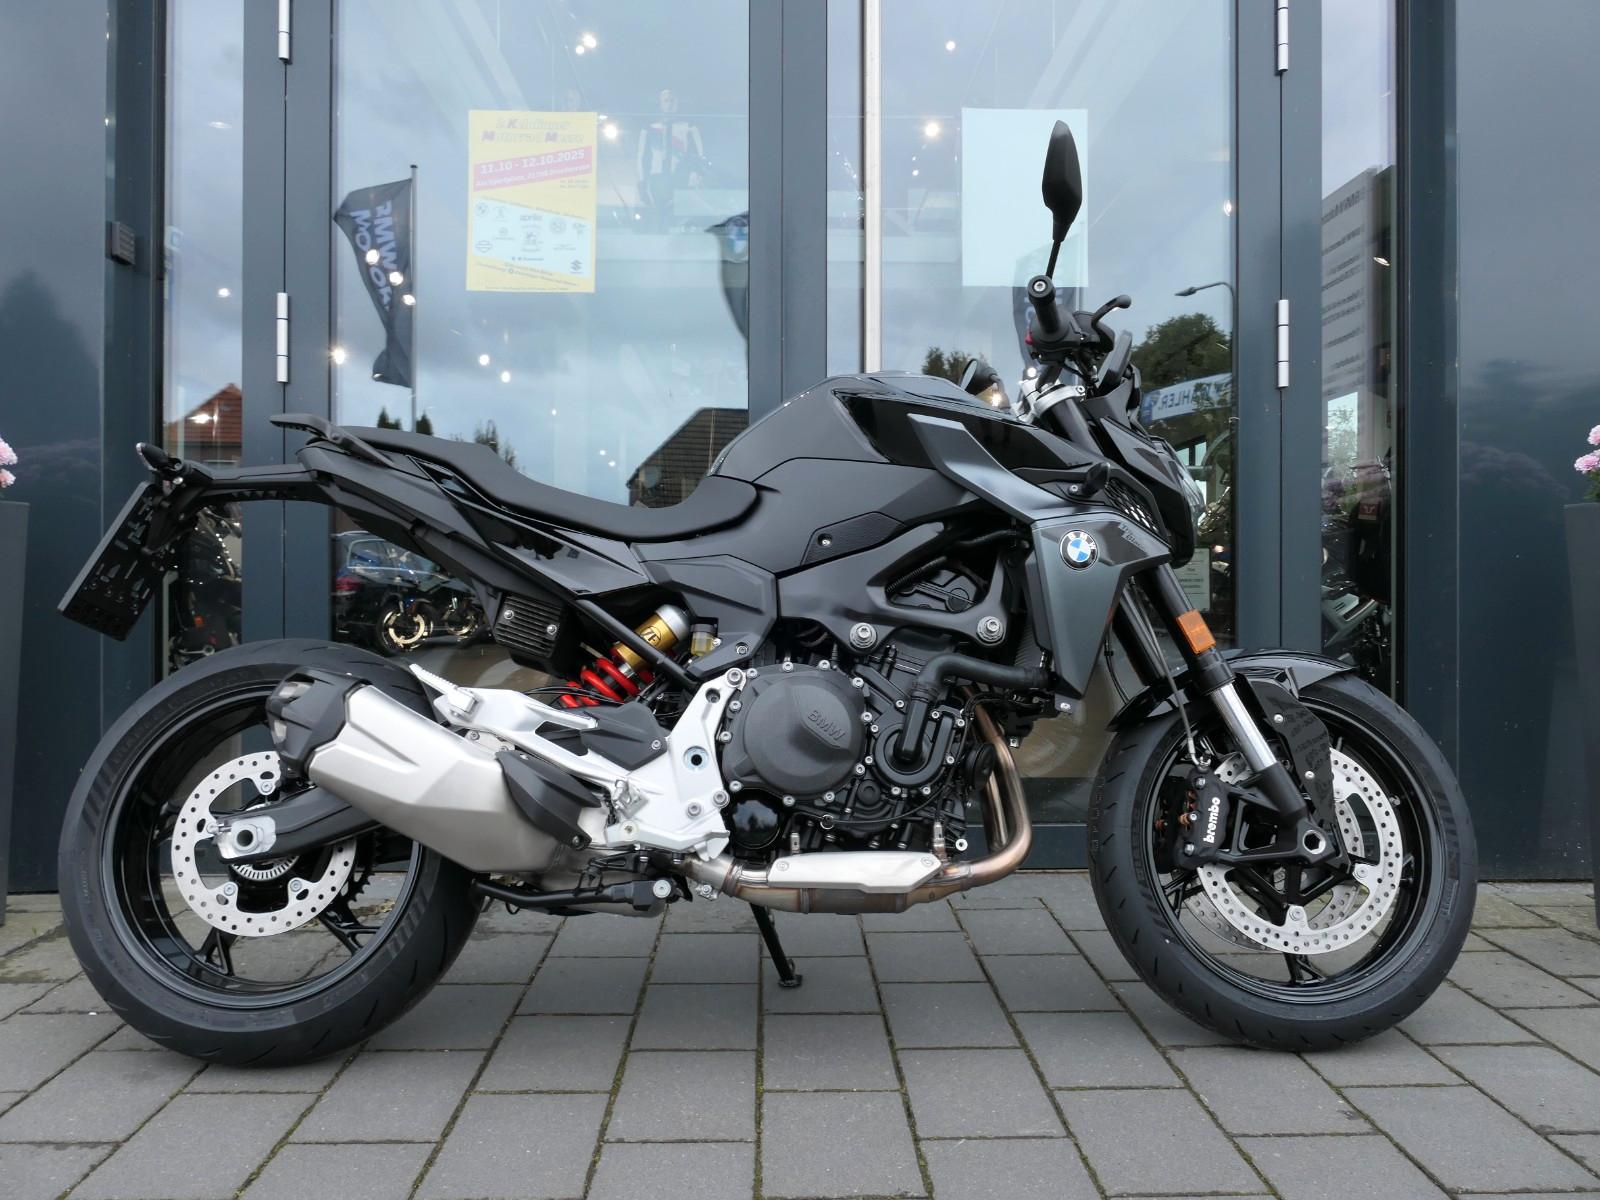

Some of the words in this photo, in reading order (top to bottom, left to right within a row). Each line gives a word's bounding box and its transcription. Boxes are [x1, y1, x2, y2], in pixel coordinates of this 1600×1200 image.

[480, 160, 513, 175] 11.10
[521, 148, 585, 169] 12.10.2025
[807, 709, 846, 741] BMW
[1202, 796, 1221, 844] brembo
